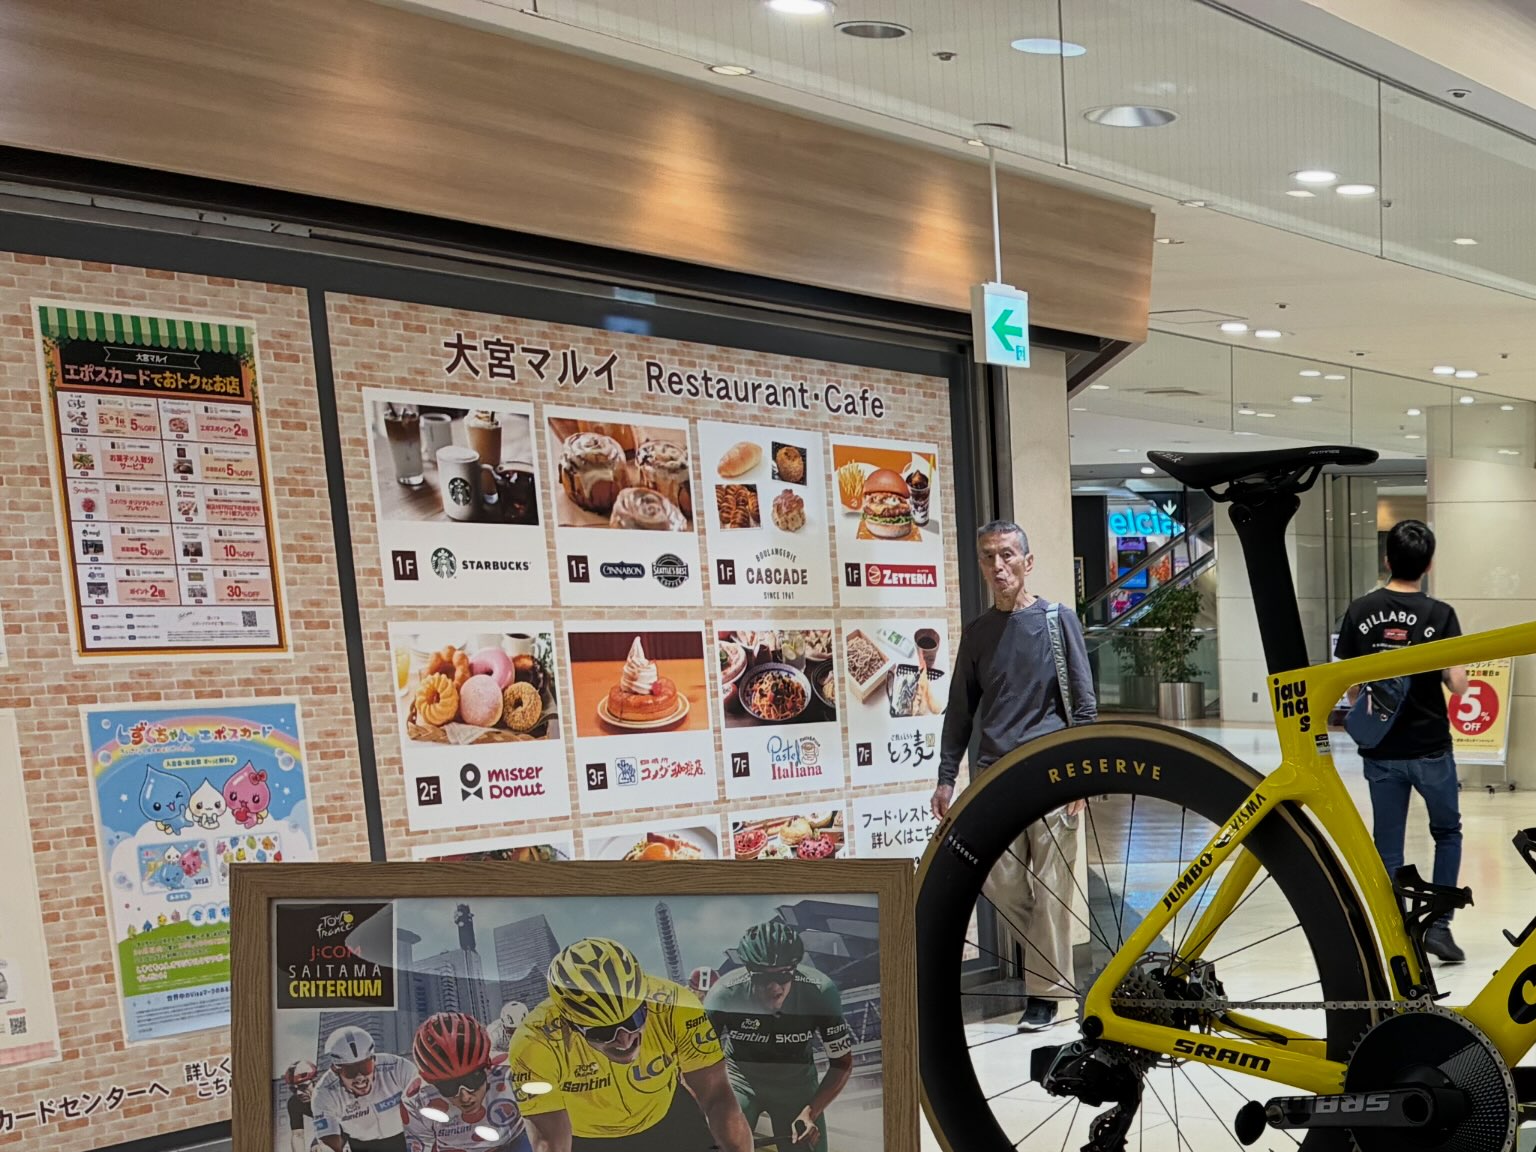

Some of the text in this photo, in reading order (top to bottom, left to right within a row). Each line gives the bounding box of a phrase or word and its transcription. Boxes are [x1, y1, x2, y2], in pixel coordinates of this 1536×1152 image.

[135, 353, 168, 364] 大宮マルイ
[443, 332, 619, 392] 大宮マルイ
[64, 364, 241, 395] エポスカードでおトクなお店
[1108, 507, 1185, 537] elcia
[755, 547, 798, 563] BOULANGERIE
[395, 554, 416, 579] 1F
[462, 558, 531, 572] STARBUCKS
[570, 559, 588, 581] 1F
[603, 565, 643, 577] CINNABON
[718, 563, 734, 582] 1F
[847, 566, 860, 583] 1F
[883, 568, 936, 586] ZETTERIA
[764, 591, 780, 600] SINCE
[1358, 611, 1436, 639] BILLABOG
[1272, 677, 1308, 713] jau
[1283, 701, 1310, 719] na
[115, 721, 275, 746] しずくちゃん エポスカード
[1462, 721, 1482, 732] OFF
[767, 735, 802, 766] Pastel
[858, 746, 872, 763] 7F
[488, 764, 544, 782] mister
[733, 755, 748, 773] 7F
[772, 761, 823, 781] Italiana
[1047, 757, 1163, 785] RESERVE
[588, 768, 605, 788] 3F
[419, 782, 440, 801] 2F
[490, 780, 546, 800] Donut
[1230, 792, 1268, 831] VISMA
[871, 826, 937, 850] 詳しくはこち
[948, 834, 980, 866] RESERVE
[193, 877, 210, 887] VISA
[1160, 852, 1214, 913] JUMBO
[310, 945, 361, 962] J:COM
[288, 964, 382, 979] SAITAMA
[288, 979, 383, 999] CRITERIUM
[728, 1030, 771, 1043] Santini
[1172, 1037, 1272, 1073] SRAM
[561, 1074, 612, 1093] Santini
